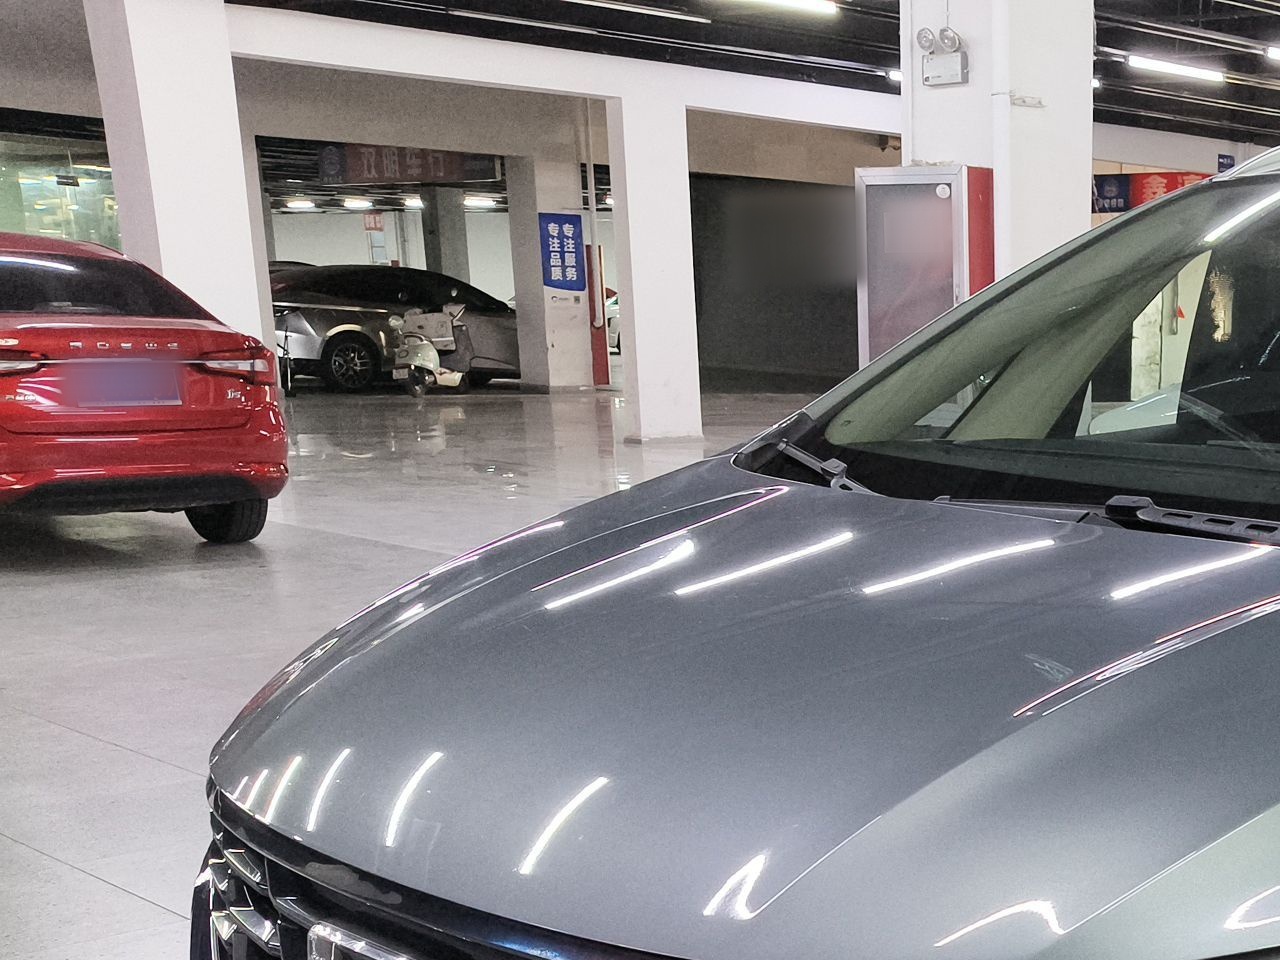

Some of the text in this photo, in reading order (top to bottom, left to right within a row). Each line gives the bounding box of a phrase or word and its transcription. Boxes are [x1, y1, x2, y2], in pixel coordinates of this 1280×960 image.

[547, 222, 563, 281] 专注品质
[562, 222, 578, 281] 专注服务
